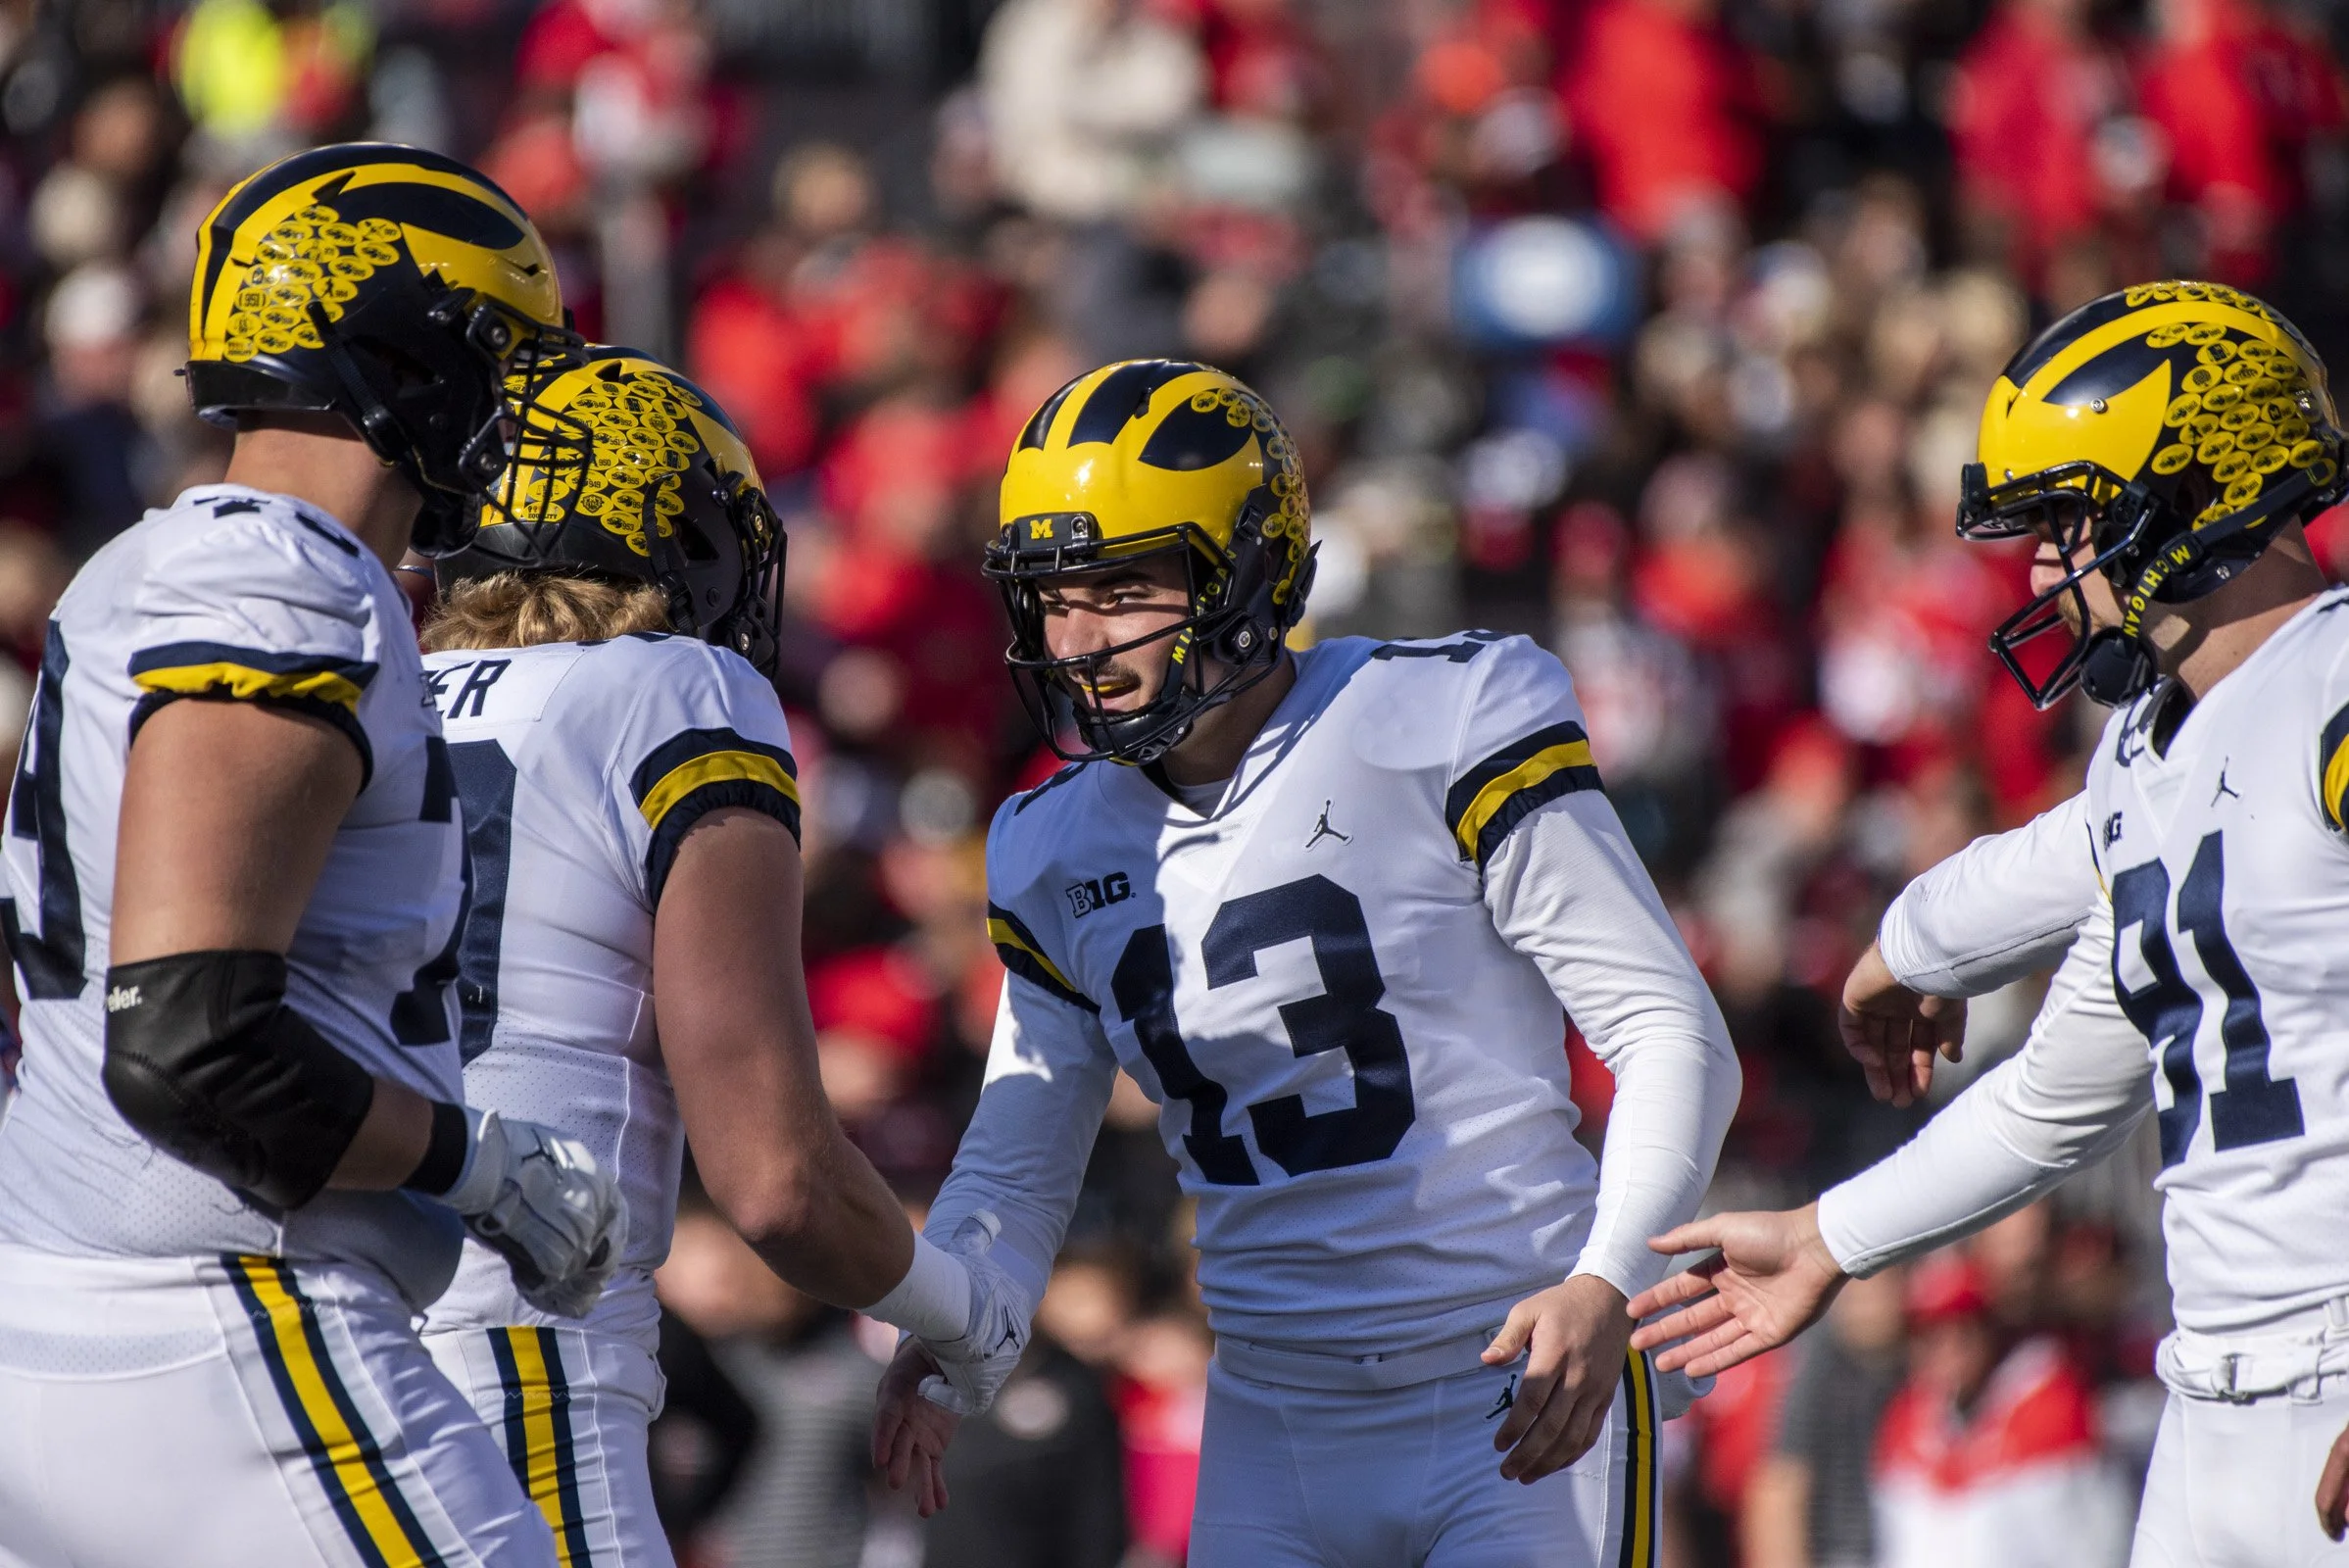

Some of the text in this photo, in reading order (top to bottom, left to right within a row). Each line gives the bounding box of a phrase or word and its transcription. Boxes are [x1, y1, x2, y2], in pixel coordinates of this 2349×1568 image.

[1030, 518, 1053, 539] M
[2124, 545, 2191, 638] MCHIGAN
[1108, 873, 1417, 1186] 13
